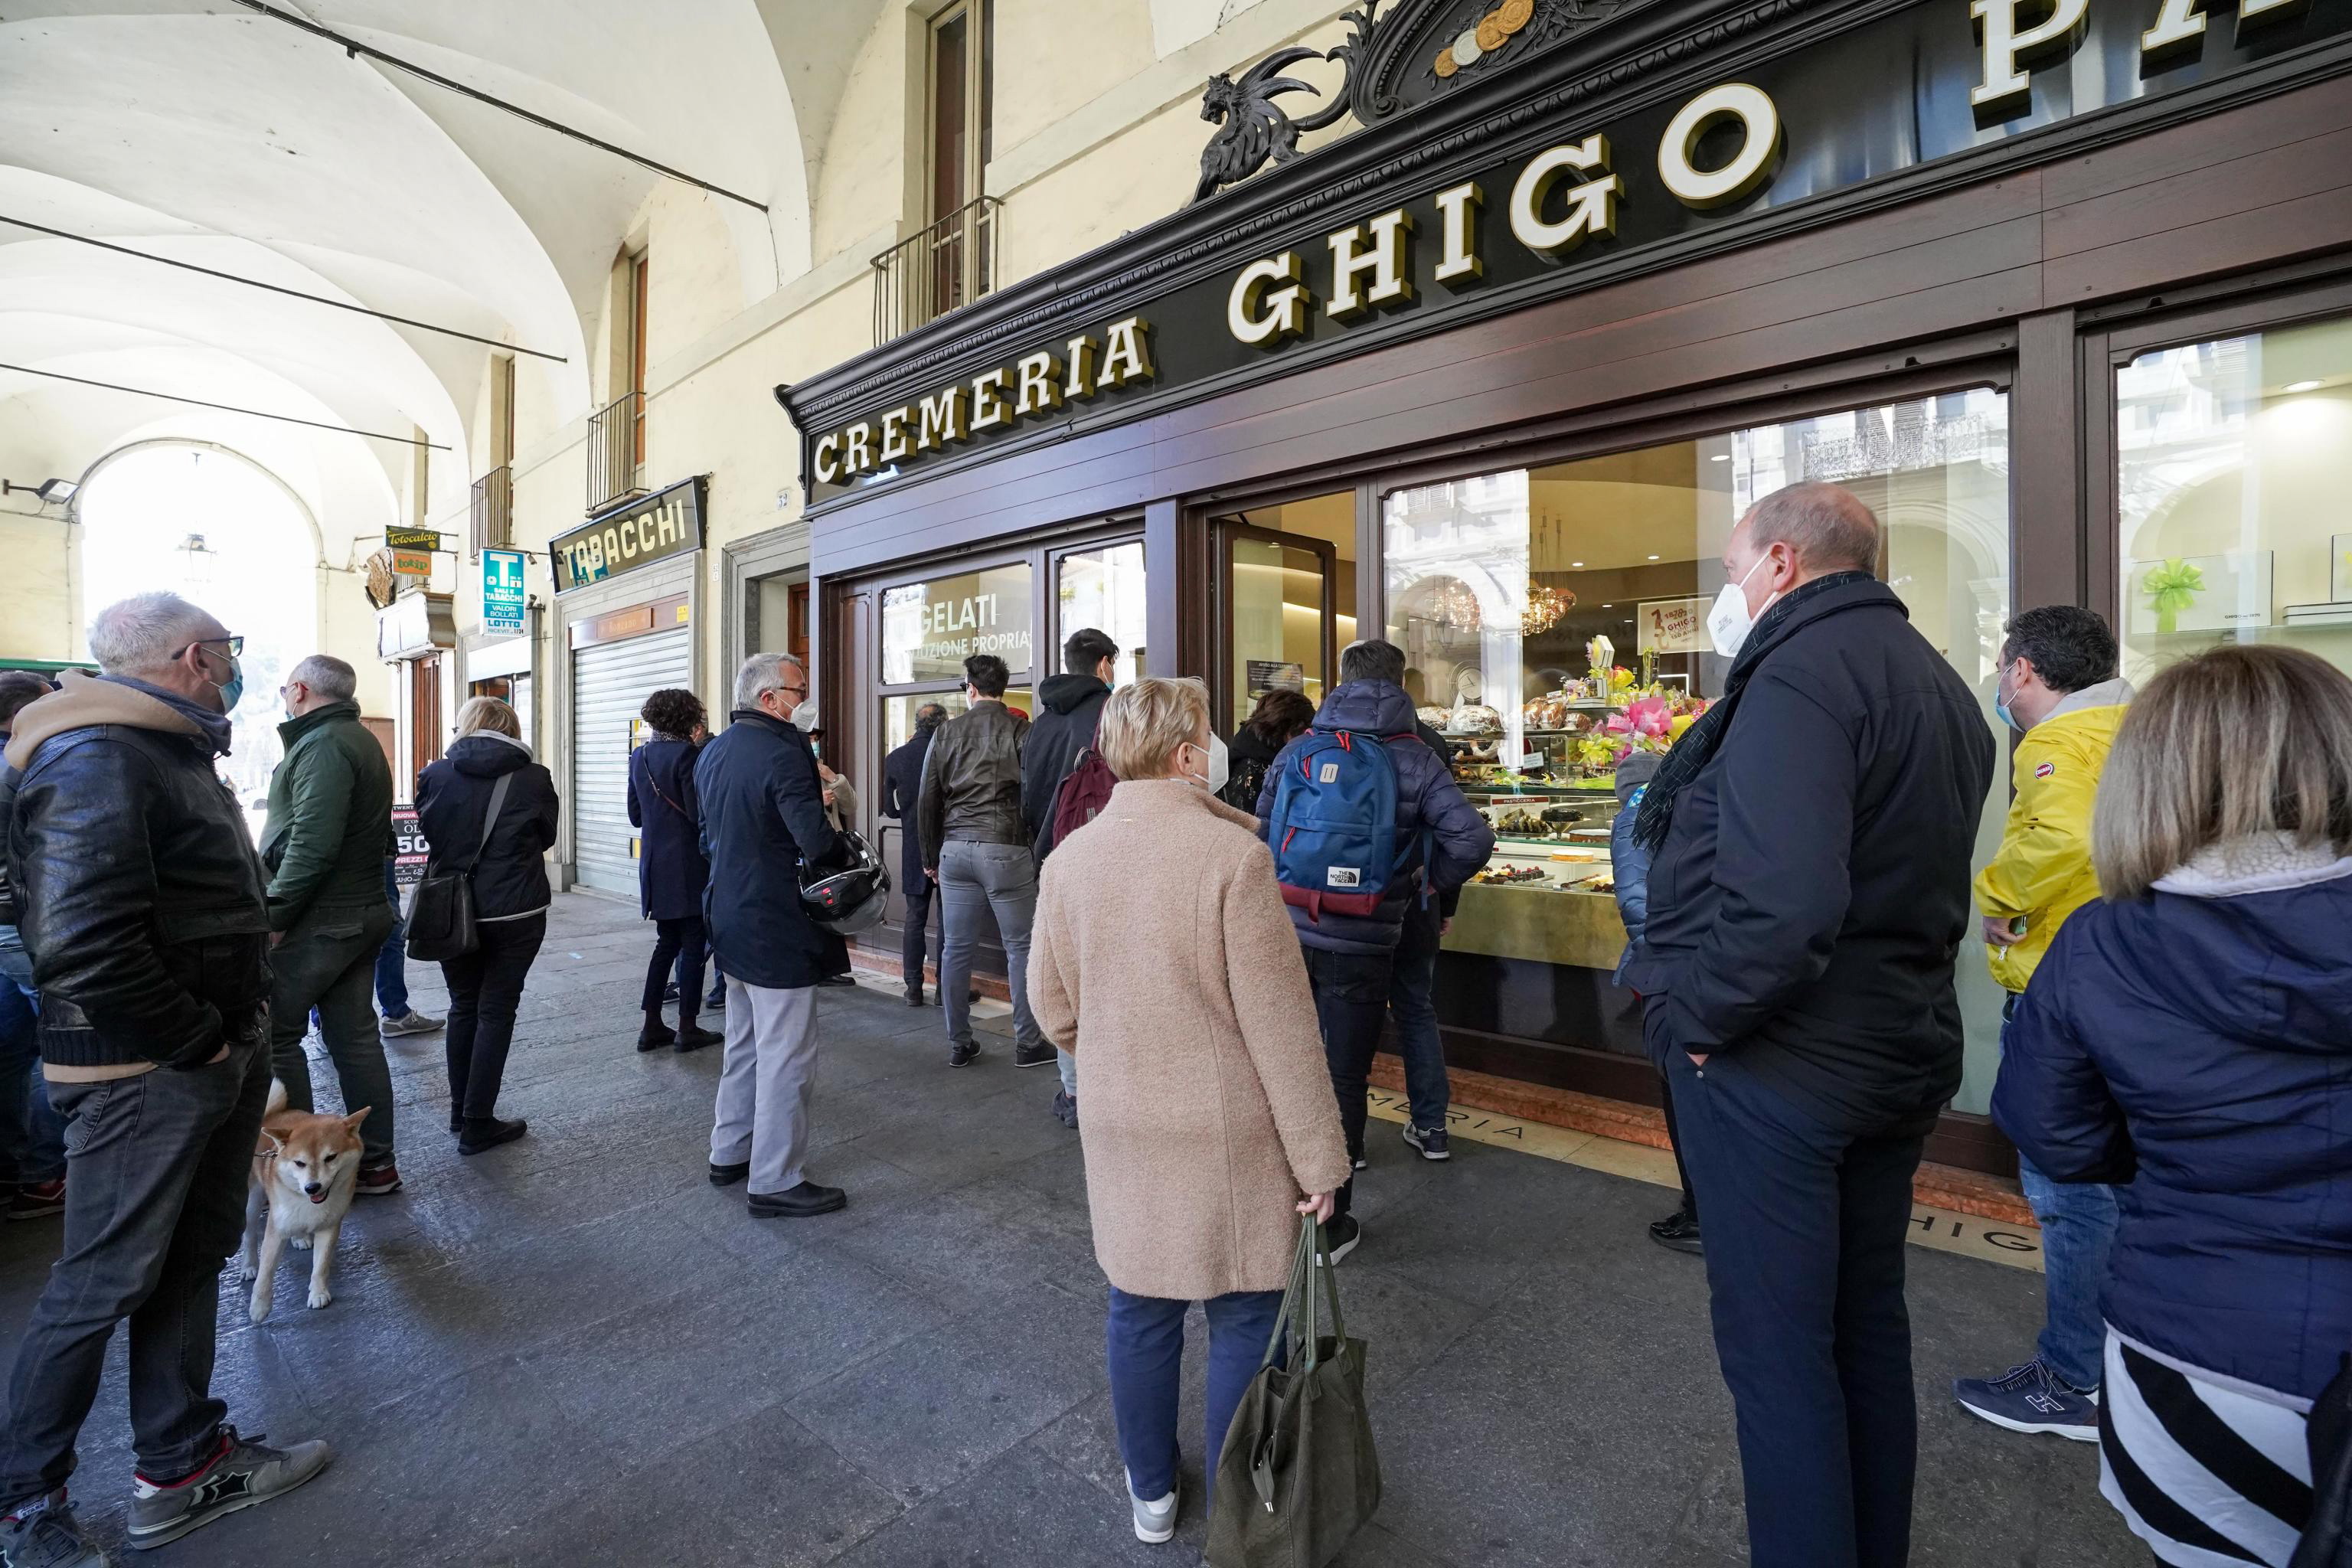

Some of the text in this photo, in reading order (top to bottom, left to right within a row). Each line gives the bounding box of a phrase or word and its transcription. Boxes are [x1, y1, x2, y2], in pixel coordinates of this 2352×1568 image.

[814, 315, 1151, 486] CREMERIA
[1227, 82, 1781, 346] GHIGO
[387, 531, 438, 545] Totocalcio
[562, 499, 686, 580] TABACCHI
[485, 592, 523, 603] TABACCHI
[488, 619, 521, 628] LOTTO
[919, 593, 997, 636] GELATI
[1668, 616, 1697, 631] GHIGO
[972, 630, 1030, 653] PROPRIA
